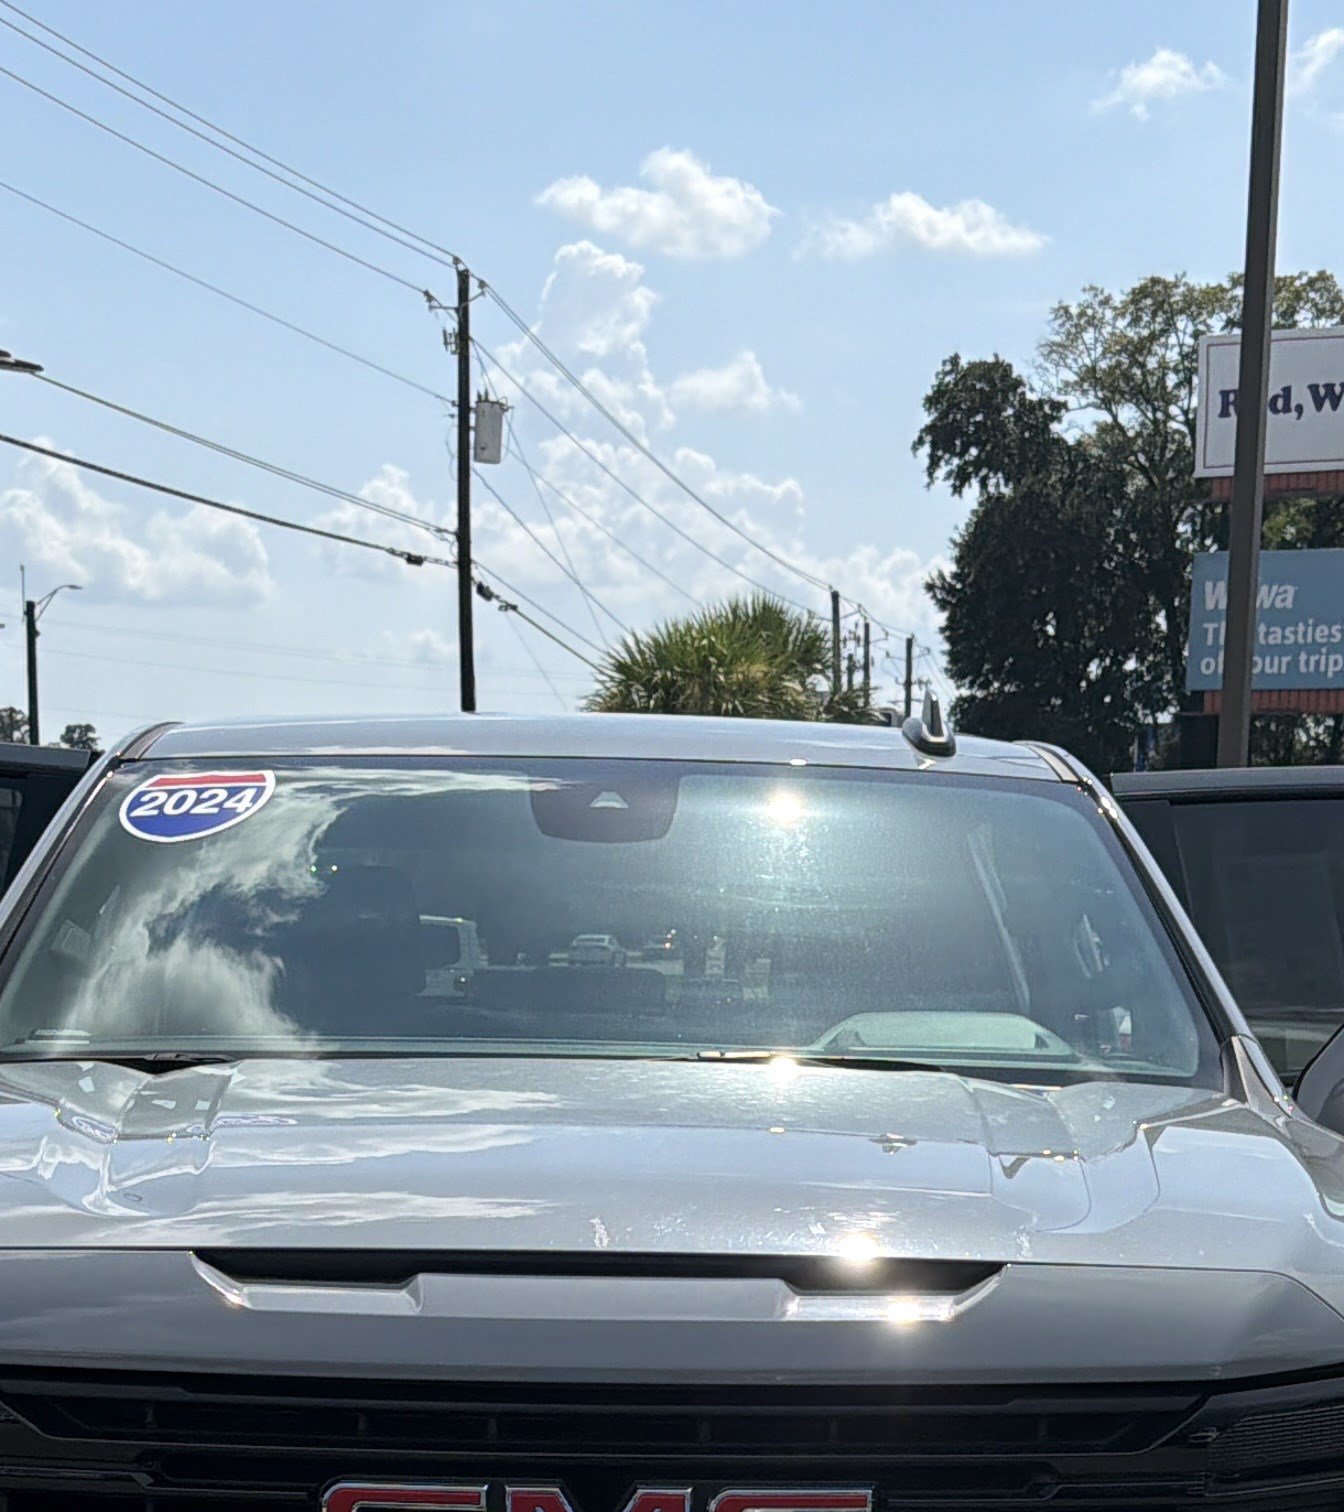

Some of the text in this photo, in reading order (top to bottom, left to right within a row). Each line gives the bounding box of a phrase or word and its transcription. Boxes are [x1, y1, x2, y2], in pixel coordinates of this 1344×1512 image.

[1218, 385, 1303, 420] Rd,
[1204, 580, 1296, 610] Wwa
[1252, 655, 1292, 675] our
[129, 787, 258, 818] 2024
